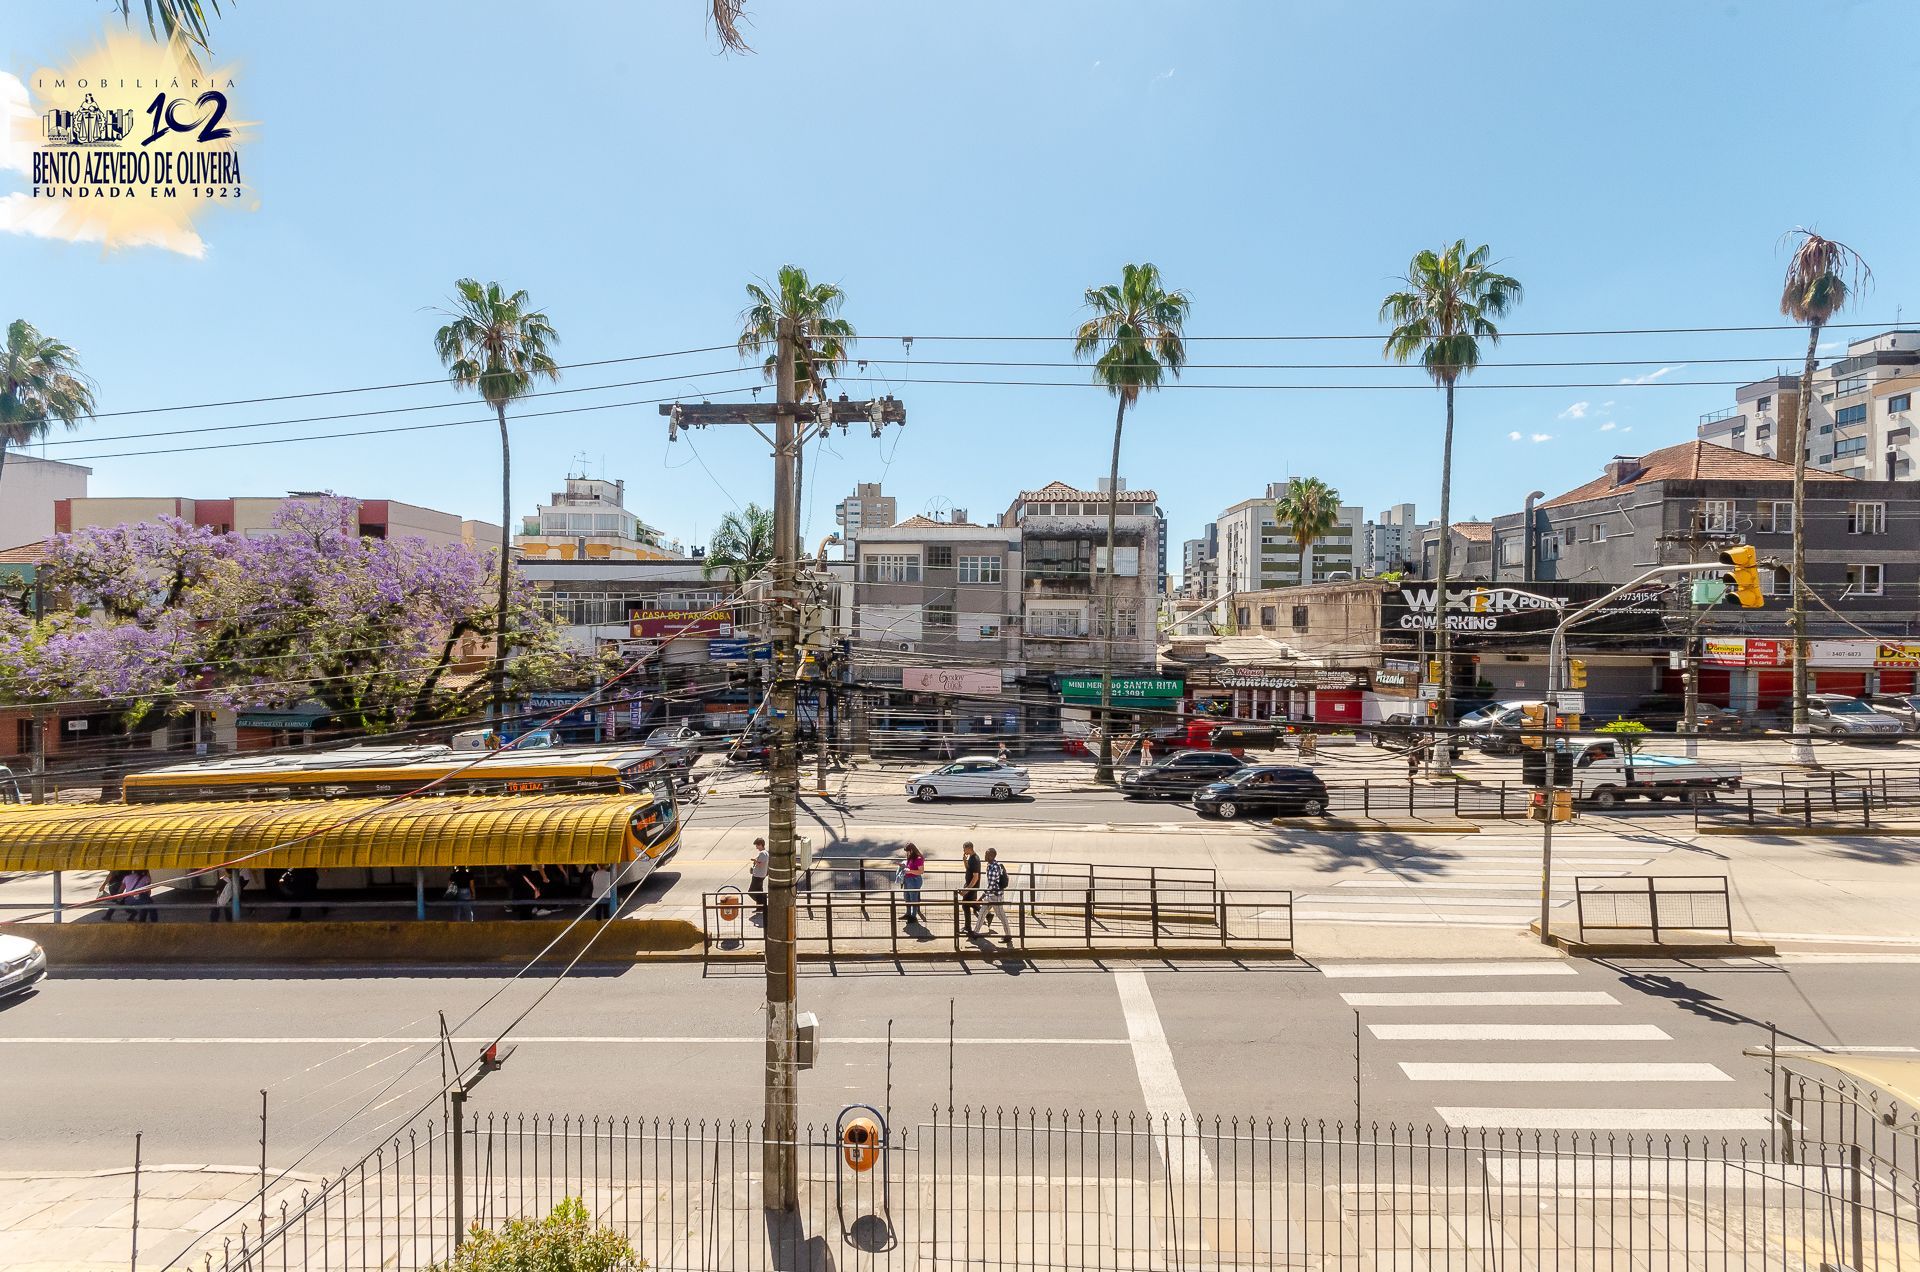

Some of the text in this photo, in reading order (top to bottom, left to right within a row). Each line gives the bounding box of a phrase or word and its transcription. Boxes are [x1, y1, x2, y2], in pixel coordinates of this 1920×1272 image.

[633, 611, 640, 620] A
[642, 611, 665, 620] CASA
[1401, 615, 1497, 630] COWRKING
[1068, 681, 1085, 689] MINI
[1123, 681, 1154, 689] SANTA
[1156, 681, 1178, 689] RITA
